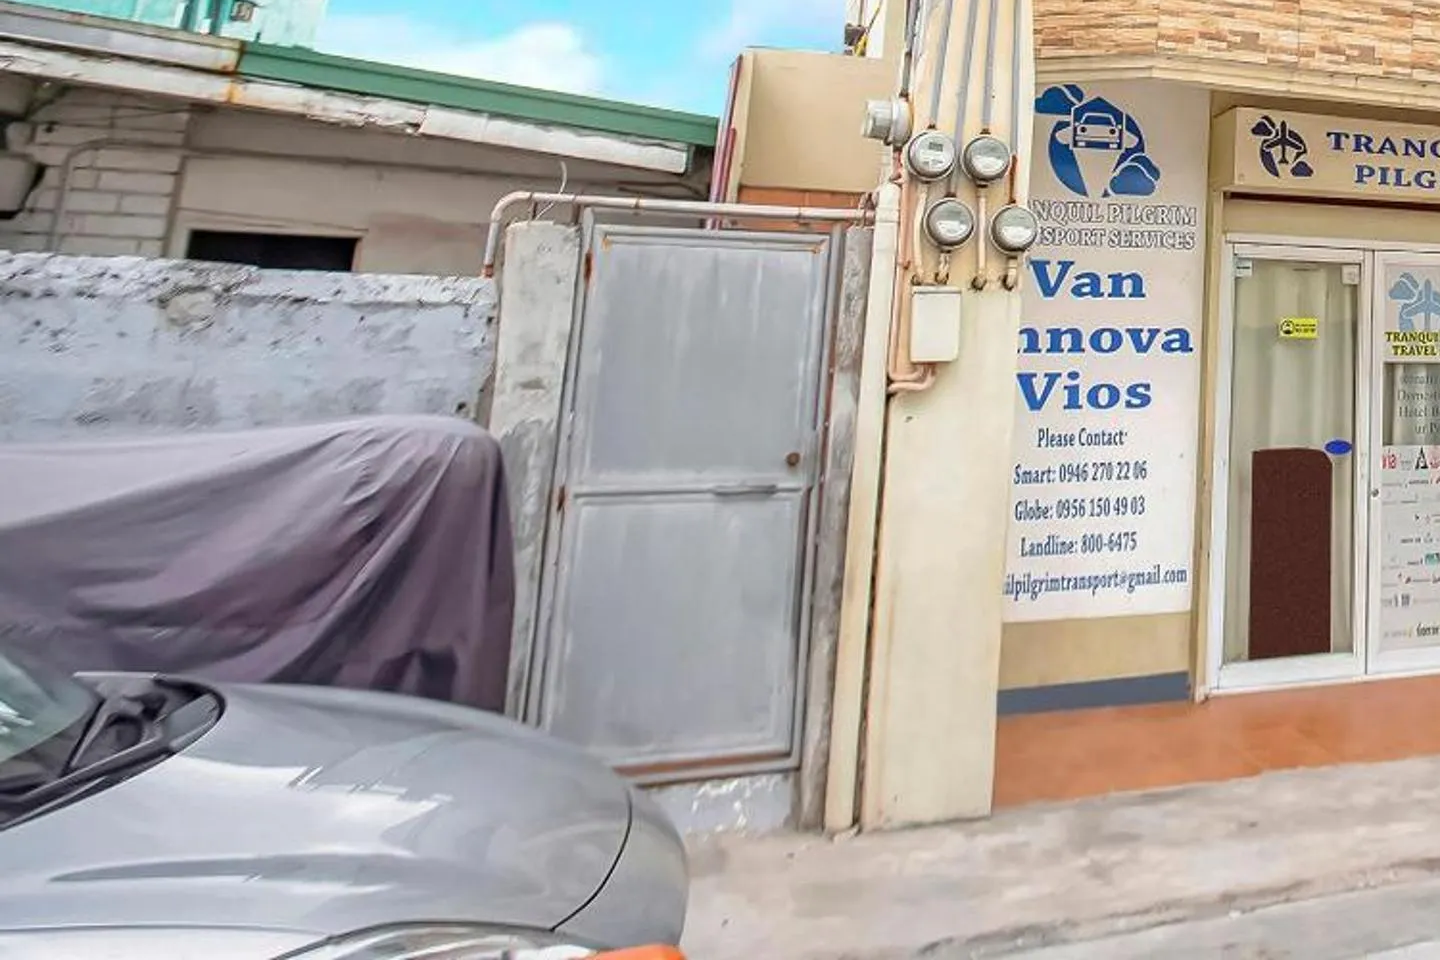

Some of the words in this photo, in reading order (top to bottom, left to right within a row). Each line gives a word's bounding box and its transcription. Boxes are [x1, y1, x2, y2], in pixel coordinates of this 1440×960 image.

[1028, 199, 1105, 227] NQUIL
[1107, 203, 1197, 227] PILGRIM
[1037, 226, 1106, 247] SPORT
[1109, 228, 1195, 250] SERVICES
[1029, 259, 1146, 298] Van
[1392, 345, 1437, 357] TRAVEL
[1016, 371, 1152, 411] Vios
[1037, 428, 1075, 448] Please
[1059, 463, 1089, 483] 0946
[1014, 498, 1053, 521] Globe:
[1089, 497, 1111, 517] 150
[1113, 496, 1129, 515] 49
[1130, 494, 1146, 515] 03
